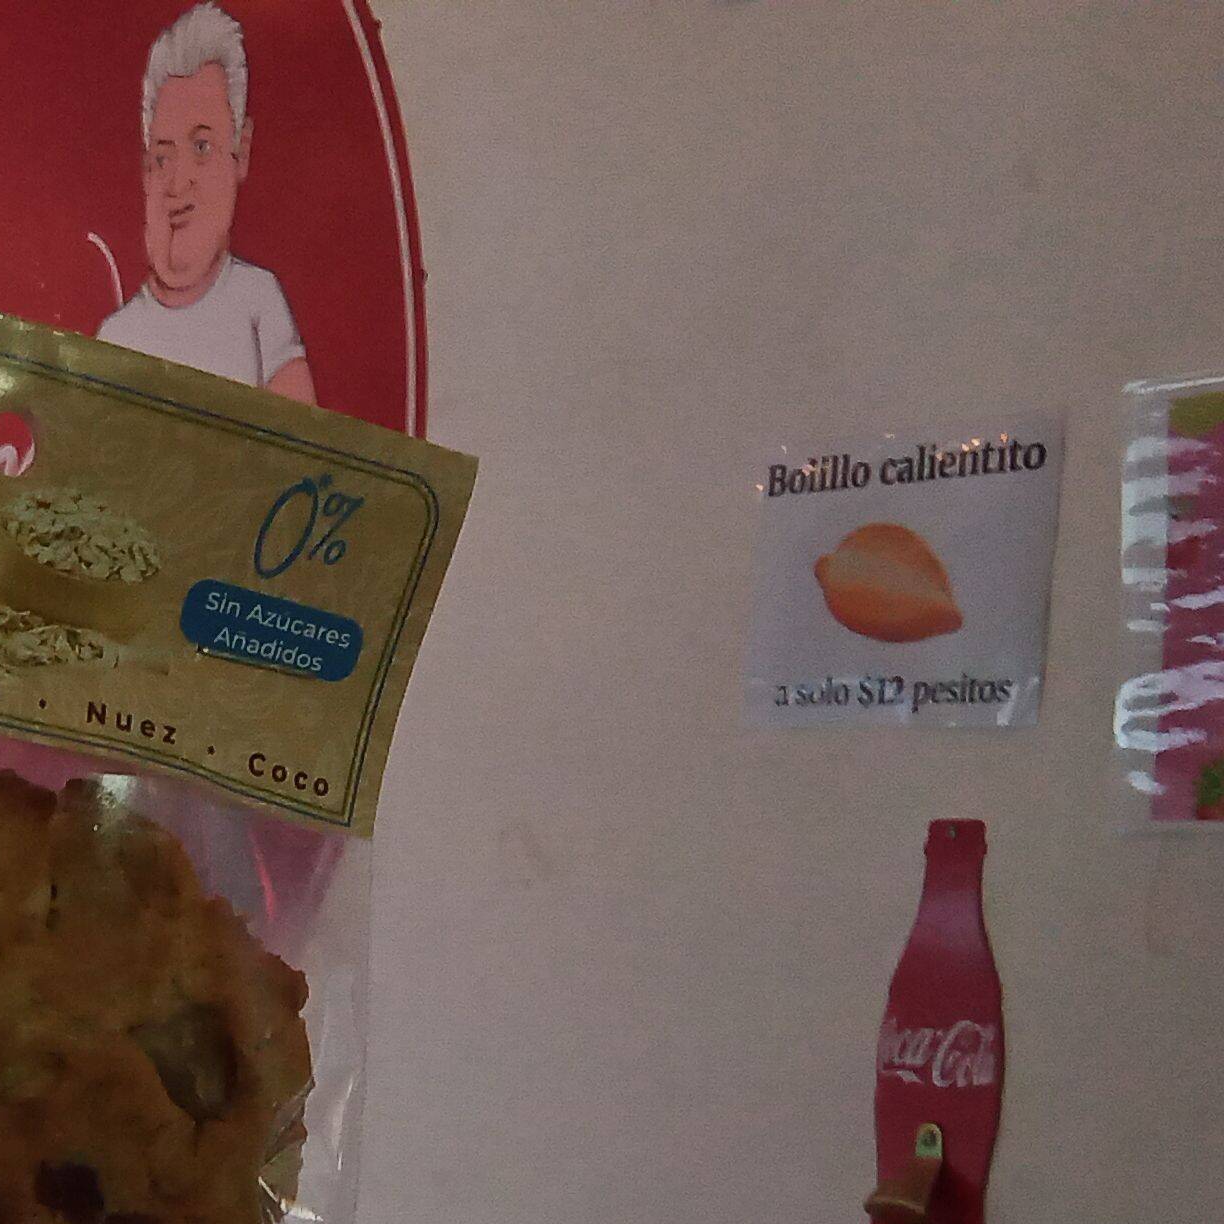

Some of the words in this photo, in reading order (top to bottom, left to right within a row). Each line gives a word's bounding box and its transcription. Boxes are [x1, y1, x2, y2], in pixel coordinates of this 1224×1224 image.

[879, 439, 1047, 485] calientito
[204, 591, 242, 618] Sin
[213, 626, 323, 673] Añadidos
[86, 700, 178, 745] Nuez
[248, 752, 330, 797] Coco
